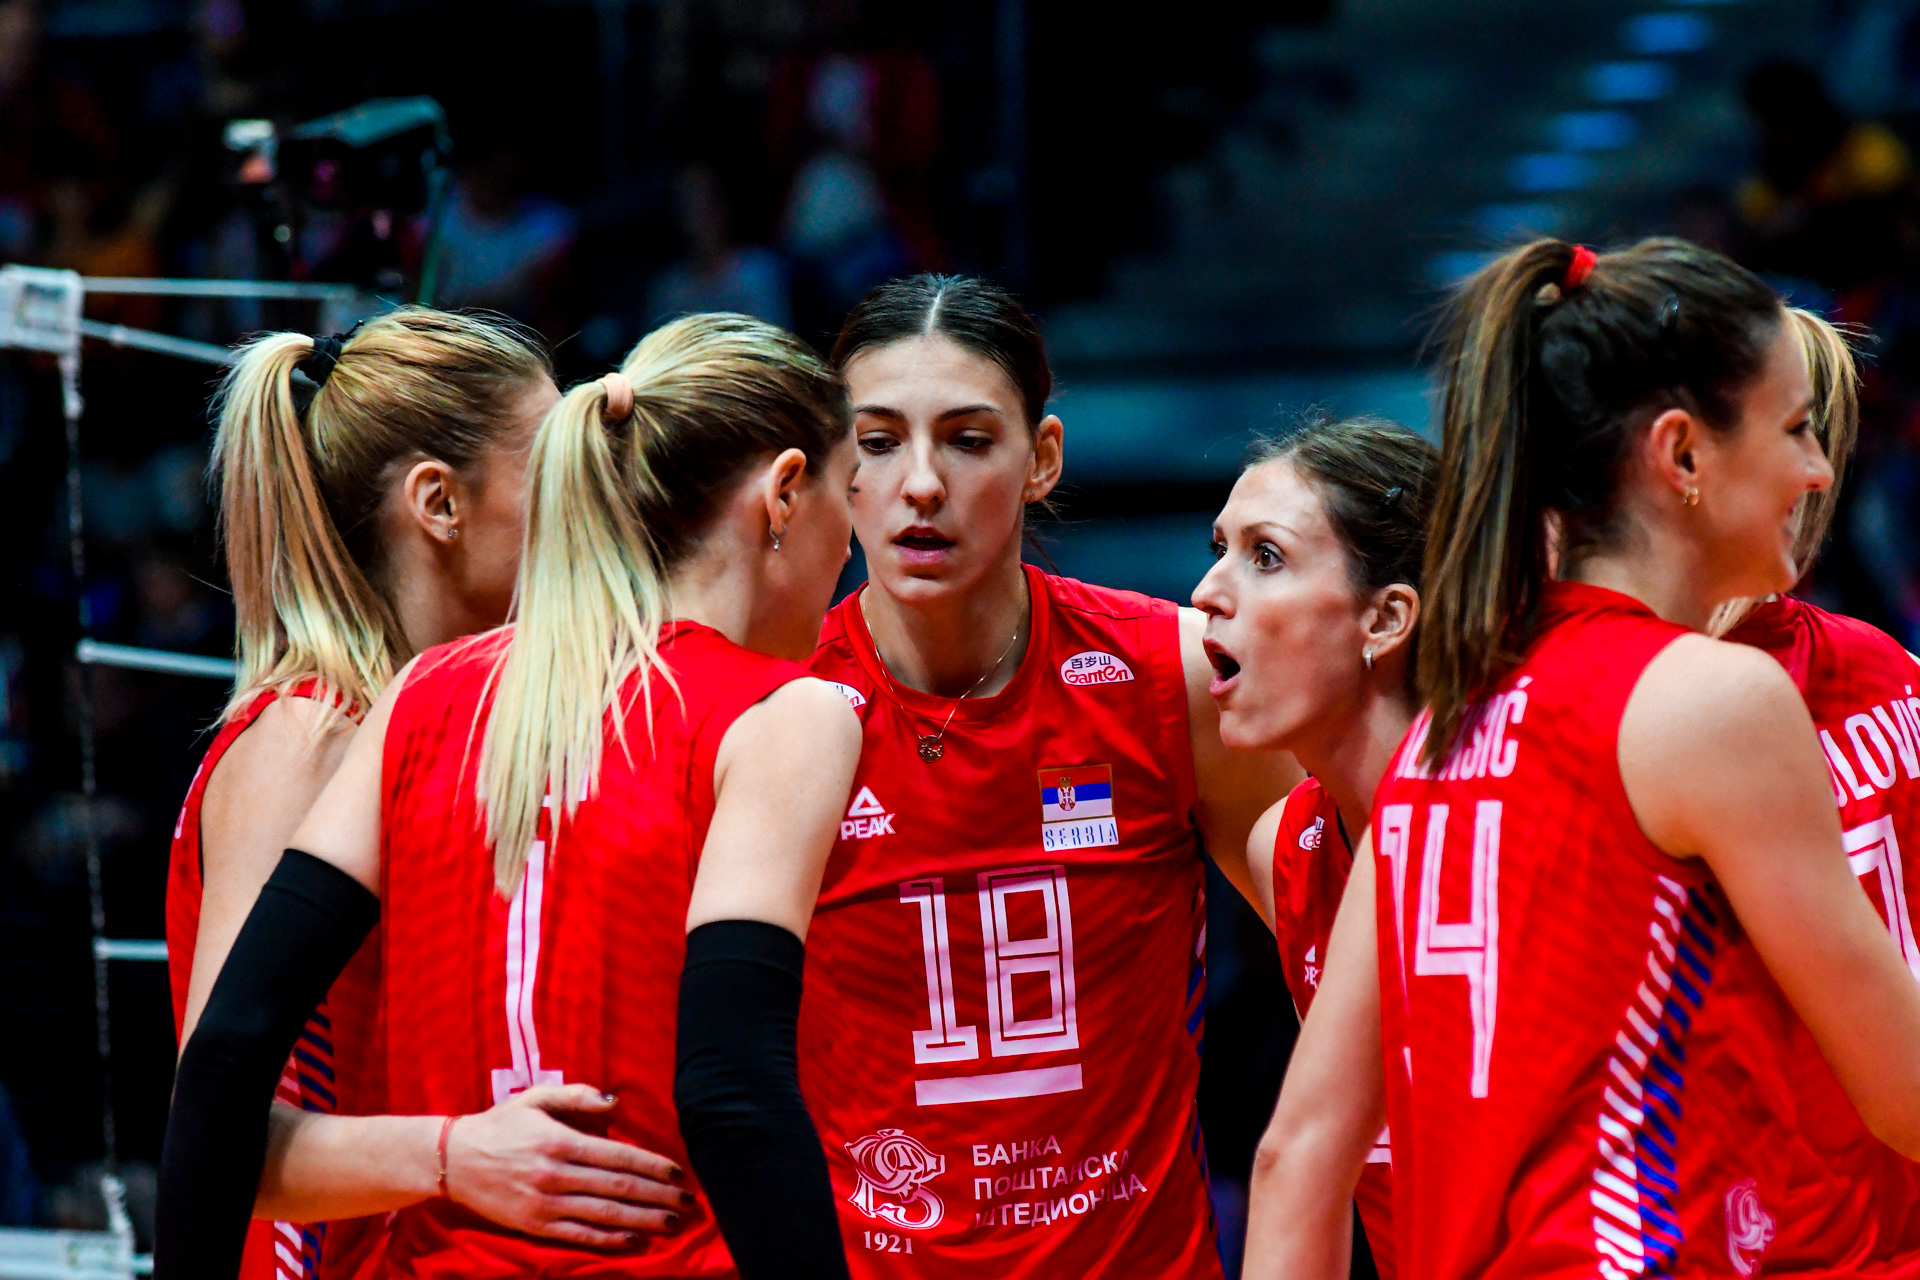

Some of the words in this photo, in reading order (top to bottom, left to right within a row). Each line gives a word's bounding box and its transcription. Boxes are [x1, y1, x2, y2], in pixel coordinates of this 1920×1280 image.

[1070, 655, 1111, 669] 百岁山
[840, 813, 896, 840] PEAK
[1045, 823, 1118, 848] SERBIA
[1381, 800, 1502, 1098] 14
[899, 864, 1080, 1065] 18
[972, 1134, 1062, 1166] БАНКА
[974, 1173, 1148, 1230] ШТЕДИОНЦА
[863, 1230, 914, 1254] 1921
